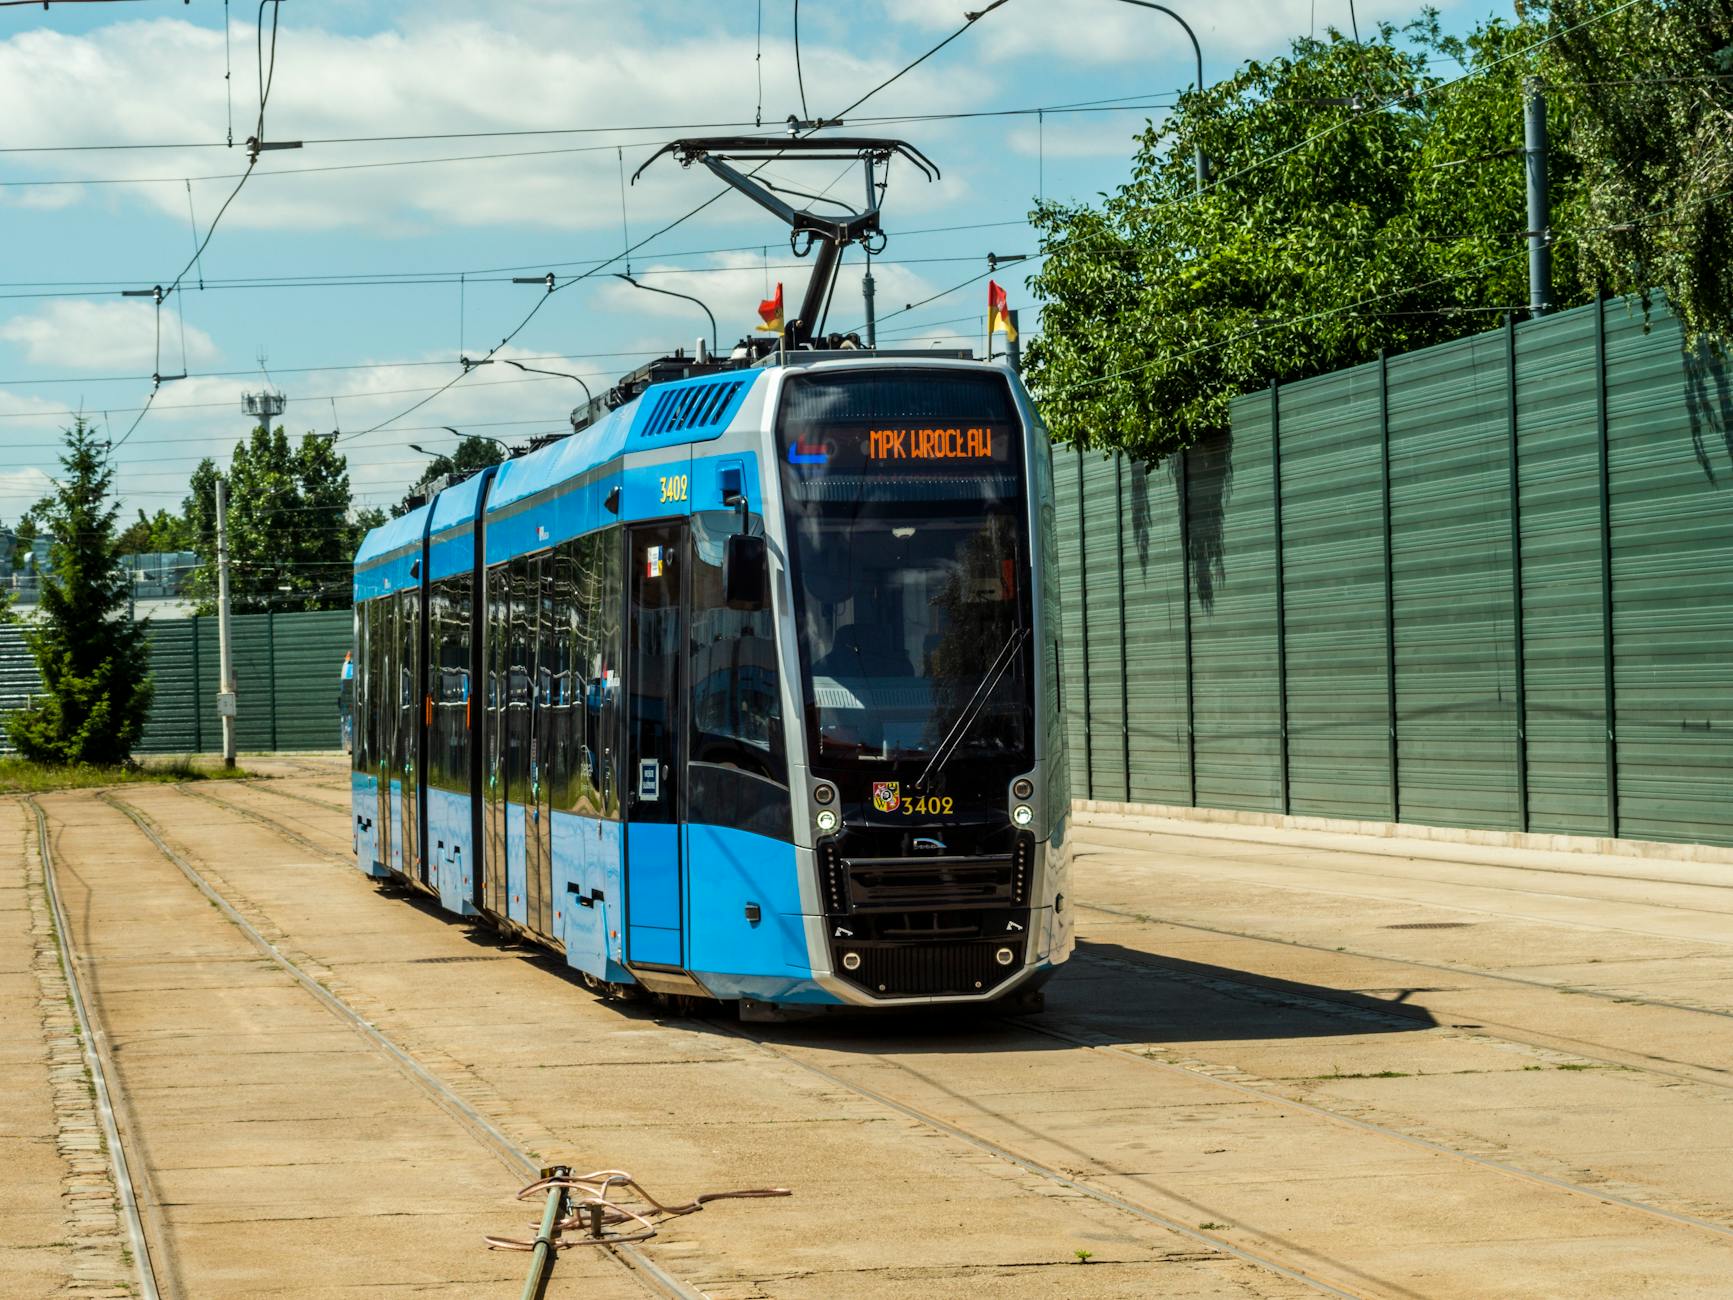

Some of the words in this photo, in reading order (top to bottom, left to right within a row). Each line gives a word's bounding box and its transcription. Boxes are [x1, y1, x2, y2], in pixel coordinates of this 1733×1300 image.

[870, 430, 906, 459] MPK
[911, 428, 992, 458] WROCŁAW
[660, 474, 688, 504] 3402
[901, 796, 954, 815] 3402
